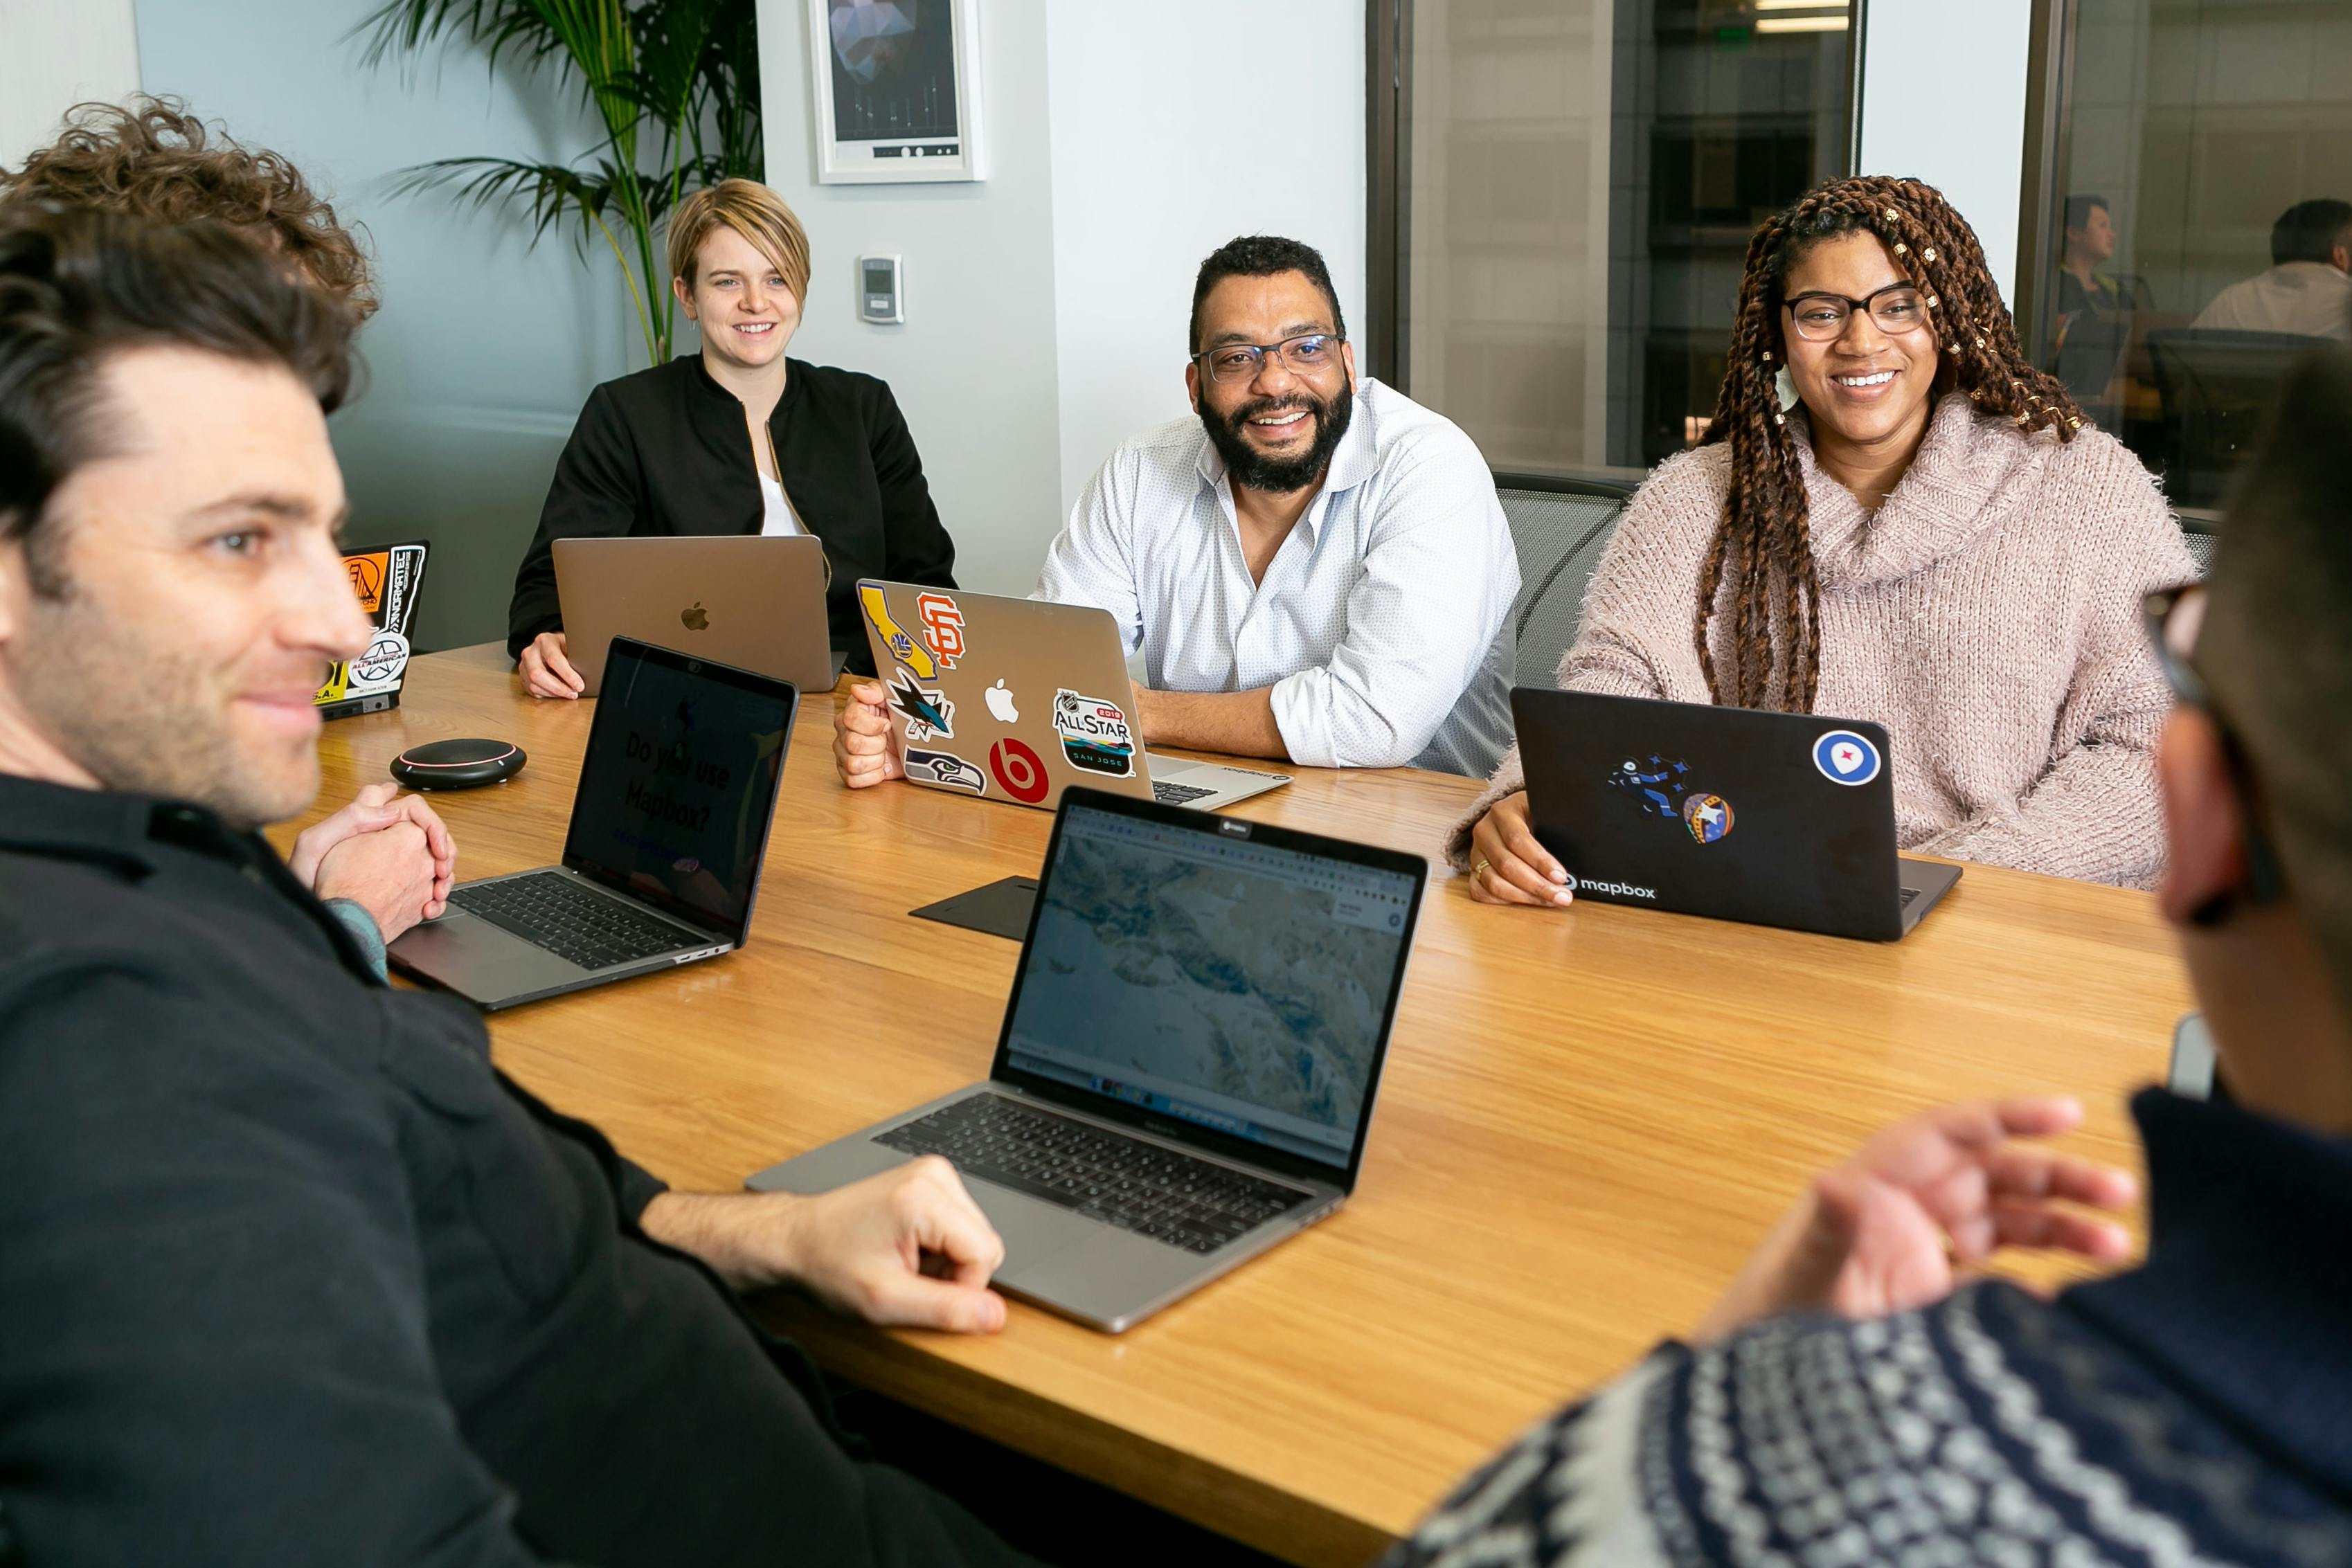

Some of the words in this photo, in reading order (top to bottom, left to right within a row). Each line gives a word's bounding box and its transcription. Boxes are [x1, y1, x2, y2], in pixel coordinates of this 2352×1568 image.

[1099, 709, 1121, 719] 2019
[625, 731, 651, 762] Do
[696, 761, 730, 791] use
[1073, 753, 1093, 762] SAN
[1097, 757, 1122, 767] JOSE
[625, 780, 710, 833] Mapbox?
[1580, 878, 1657, 899] mapbox
